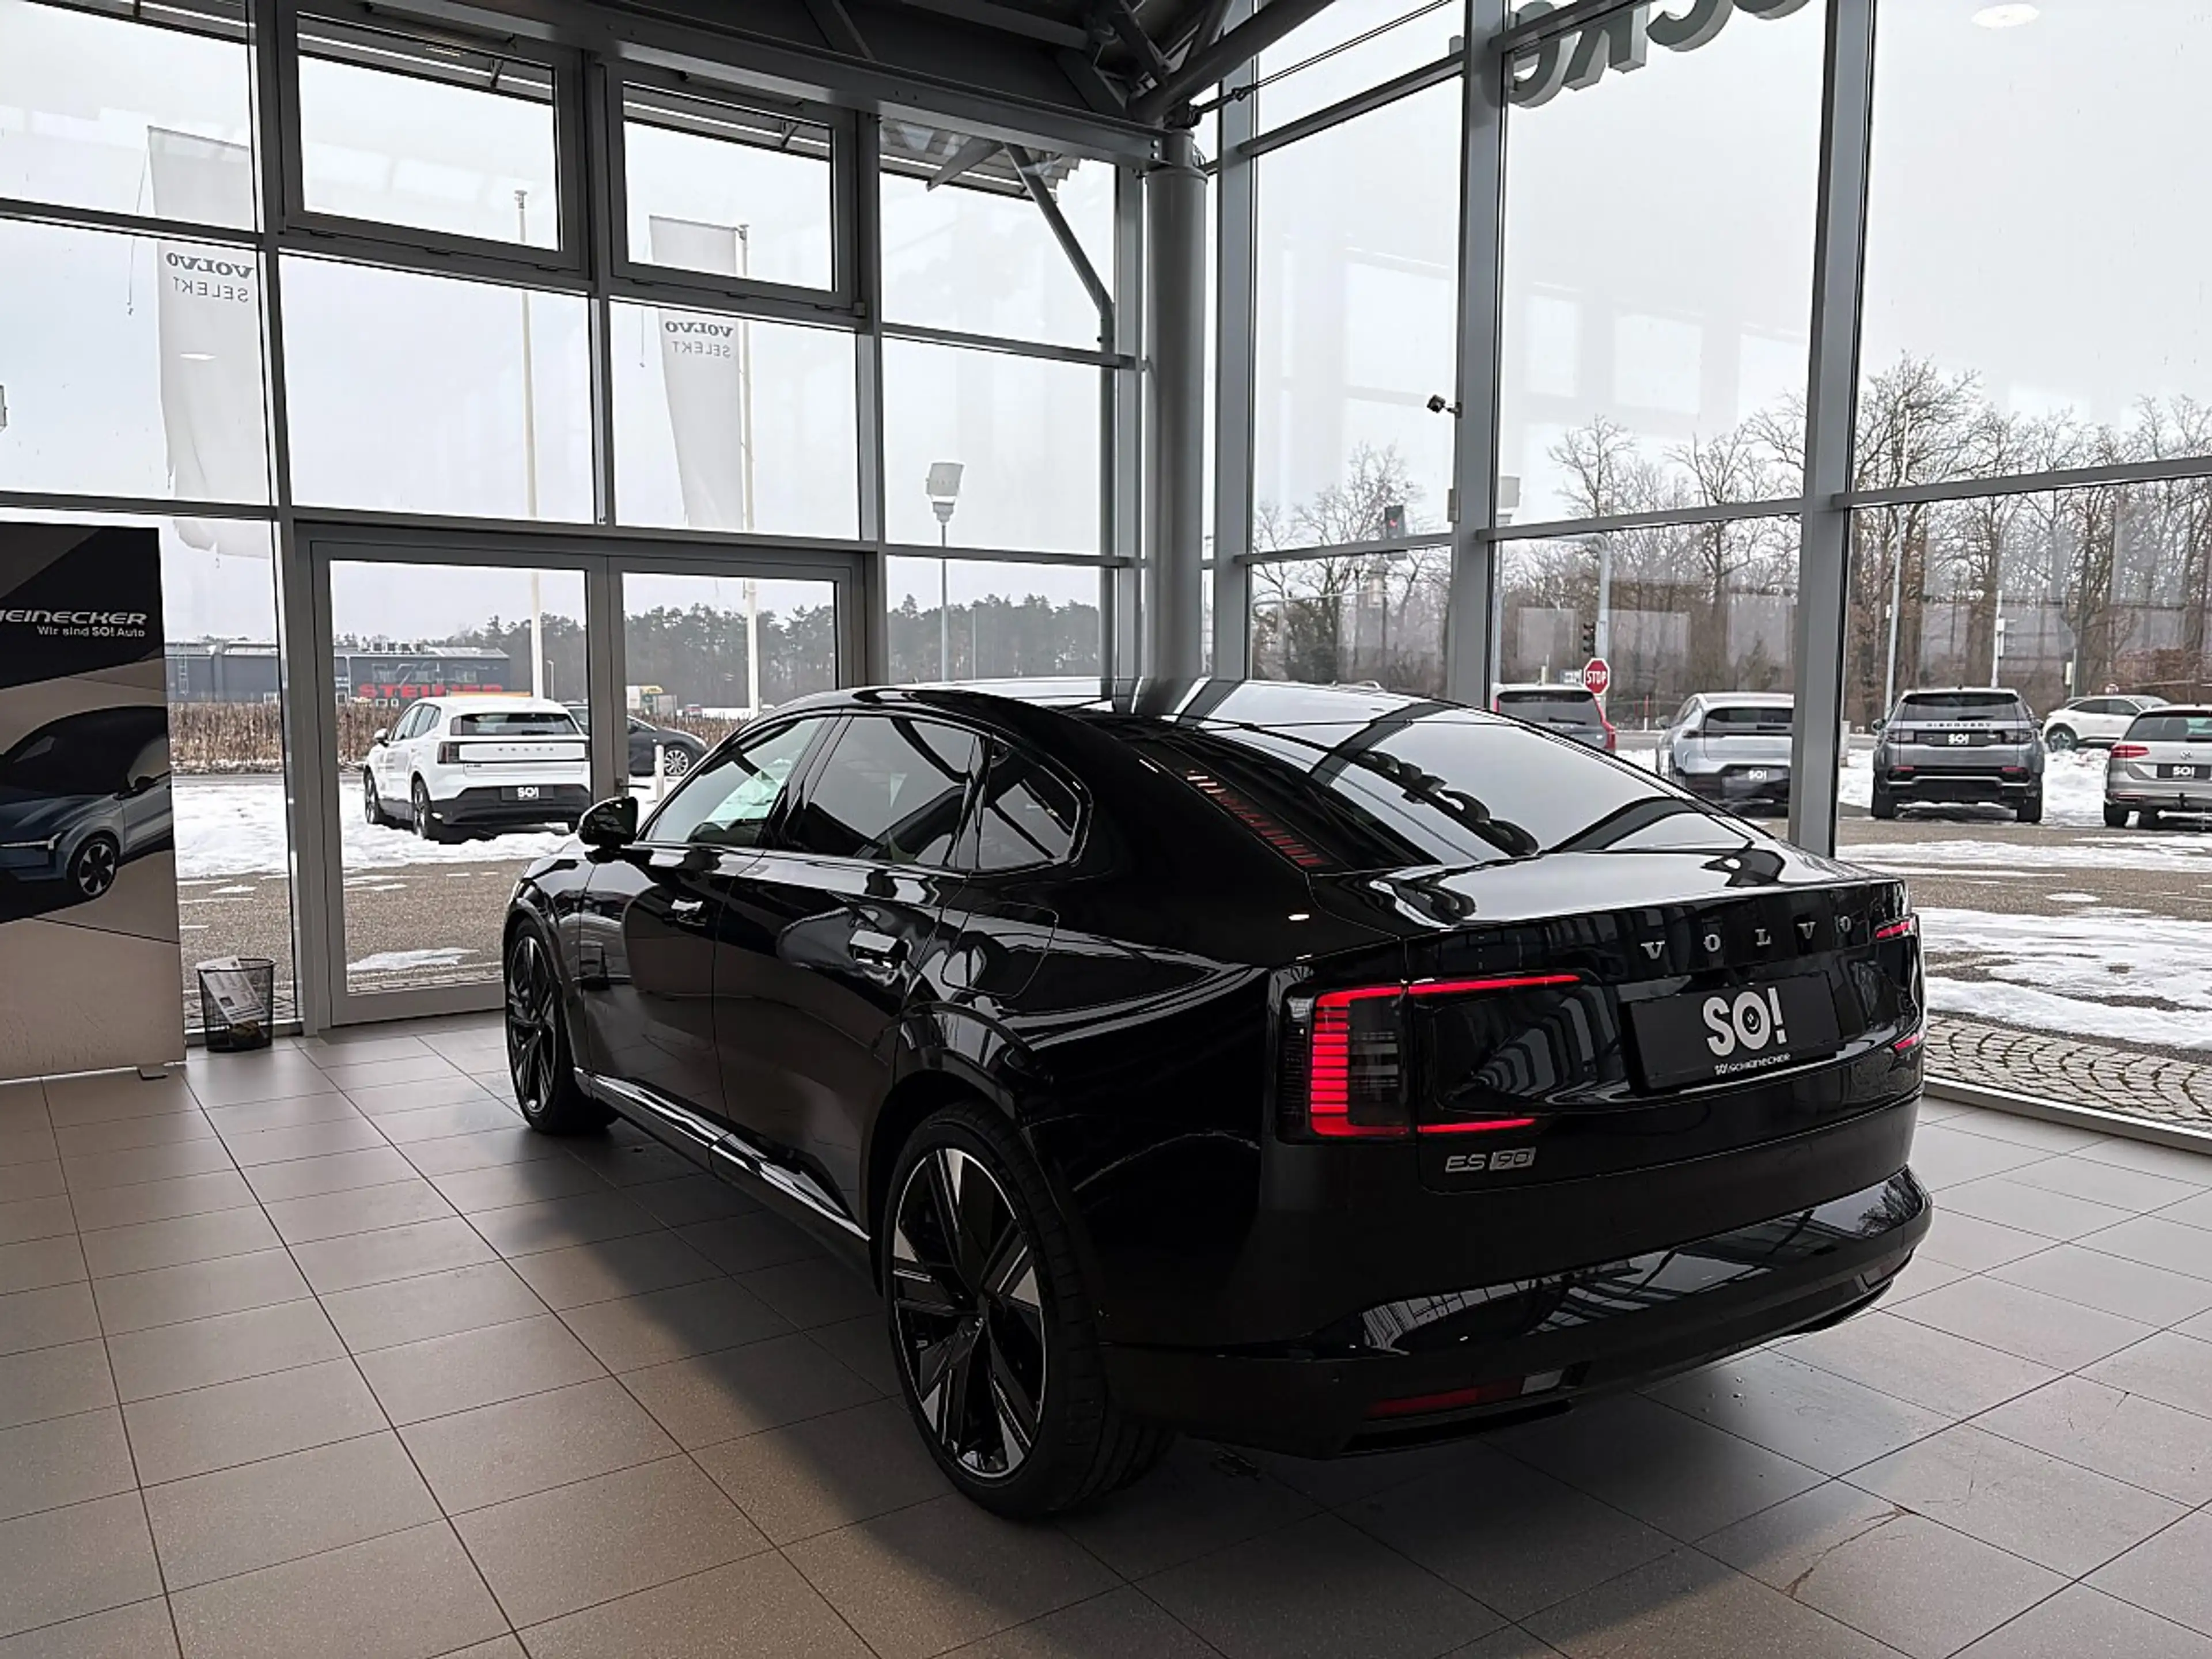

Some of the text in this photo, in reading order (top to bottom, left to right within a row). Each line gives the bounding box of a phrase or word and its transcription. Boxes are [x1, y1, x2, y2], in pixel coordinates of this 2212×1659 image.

[37, 625, 145, 637] Wir sind SO! Auto
[1587, 671, 1606, 684] STOP
[1641, 916, 1851, 960] VOLVO
[1703, 987, 1787, 1056] SO!
